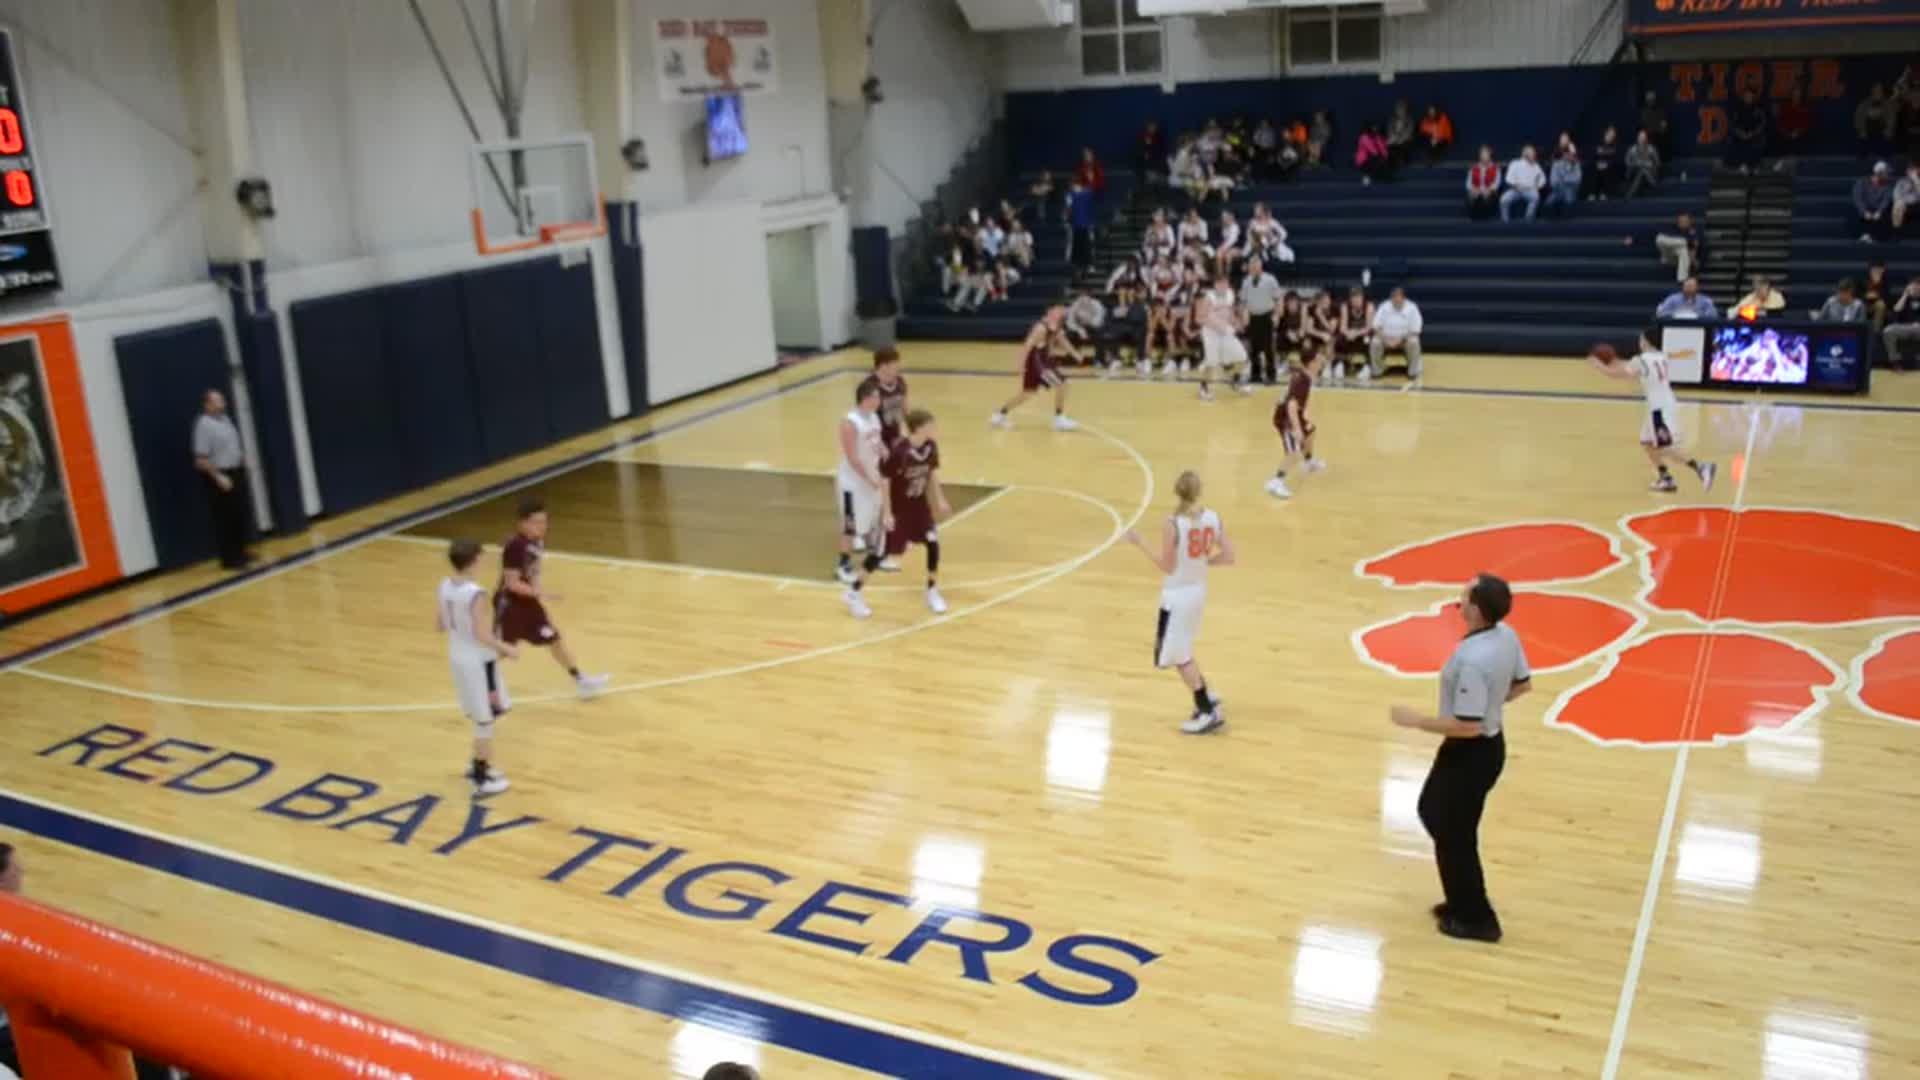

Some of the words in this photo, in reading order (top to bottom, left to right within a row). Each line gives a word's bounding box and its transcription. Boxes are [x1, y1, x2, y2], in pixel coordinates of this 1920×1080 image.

[36, 723, 275, 795] RED
[257, 772, 545, 856] BAY
[541, 826, 1163, 1007] TIGERS
